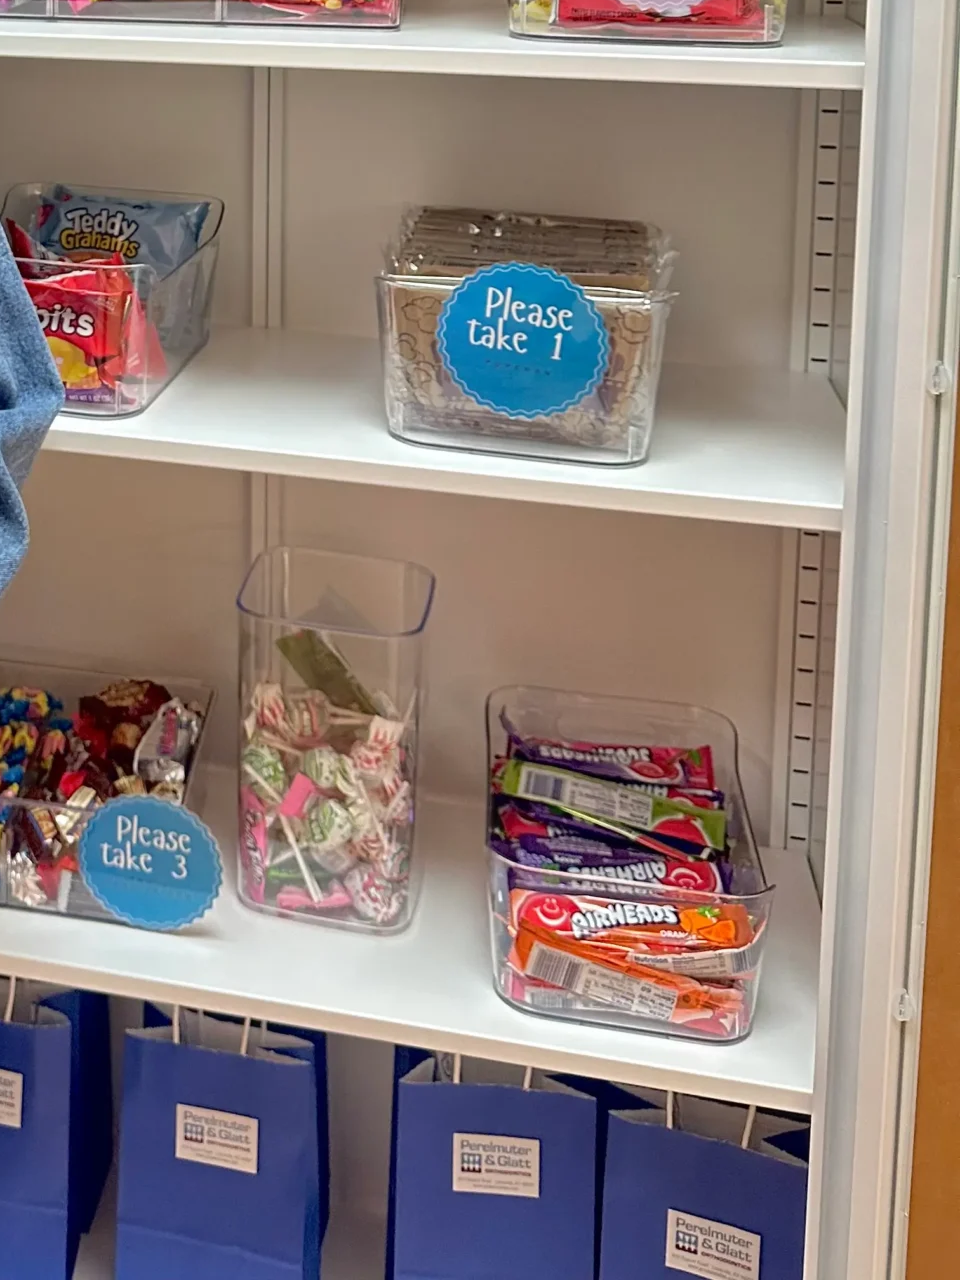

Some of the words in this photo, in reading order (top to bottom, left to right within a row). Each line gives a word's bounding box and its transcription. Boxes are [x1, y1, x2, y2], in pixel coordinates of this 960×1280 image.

[66, 209, 138, 241] Teddy
[61, 228, 139, 258] Grahams
[486, 286, 573, 331] Please
[467, 317, 528, 354] take
[550, 332, 563, 360] 1
[117, 814, 191, 854] Please
[100, 840, 153, 875] take
[171, 854, 188, 880] 3
[571, 903, 680, 939] AIRHEADS
[461, 1139, 532, 1155] Perelmuter
[484, 1154, 495, 1166] &
[497, 1155, 531, 1169] Glatt
[676, 1217, 752, 1248] Perelmuter
[701, 1238, 713, 1251] &
[715, 1241, 751, 1263] Glatt
